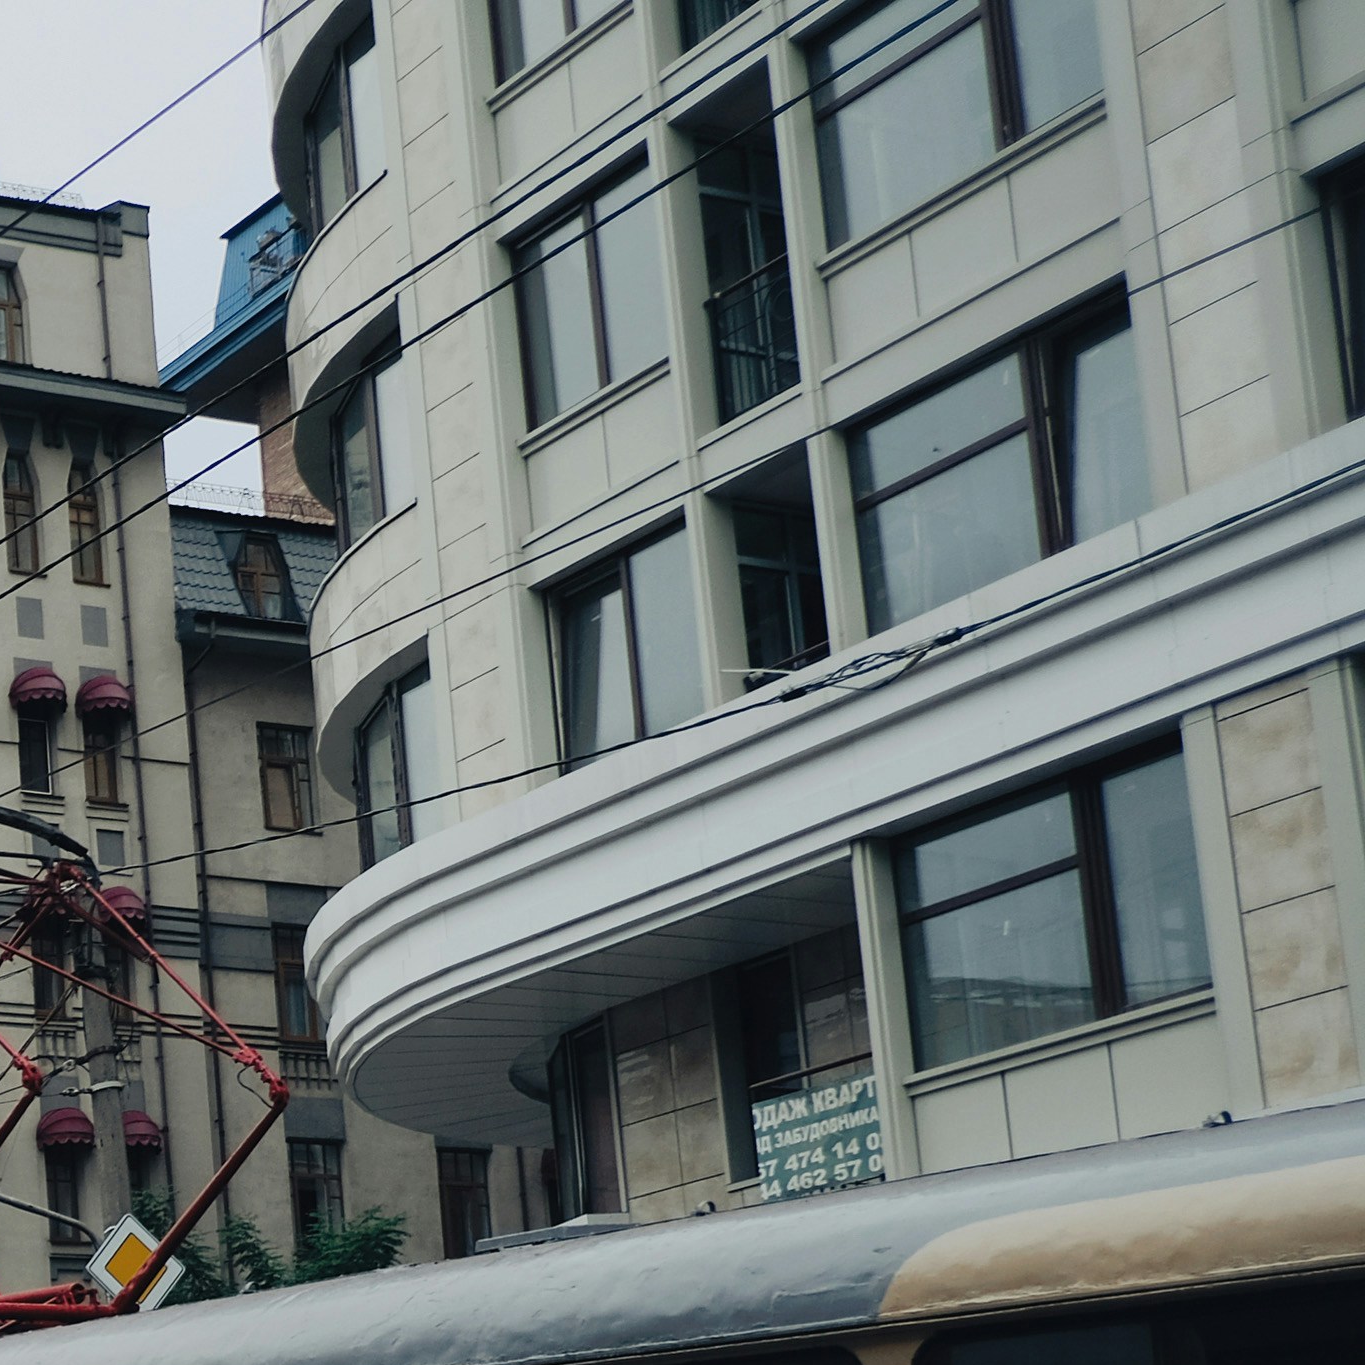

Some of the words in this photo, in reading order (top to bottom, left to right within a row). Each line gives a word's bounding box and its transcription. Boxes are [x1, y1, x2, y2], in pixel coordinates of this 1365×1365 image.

[774, 1106, 879, 1148] ЗАБУДОВНИКА
[784, 1146, 826, 1171] 474
[831, 1138, 861, 1159] 14
[786, 1168, 828, 1192] 462
[833, 1159, 862, 1181] 57
